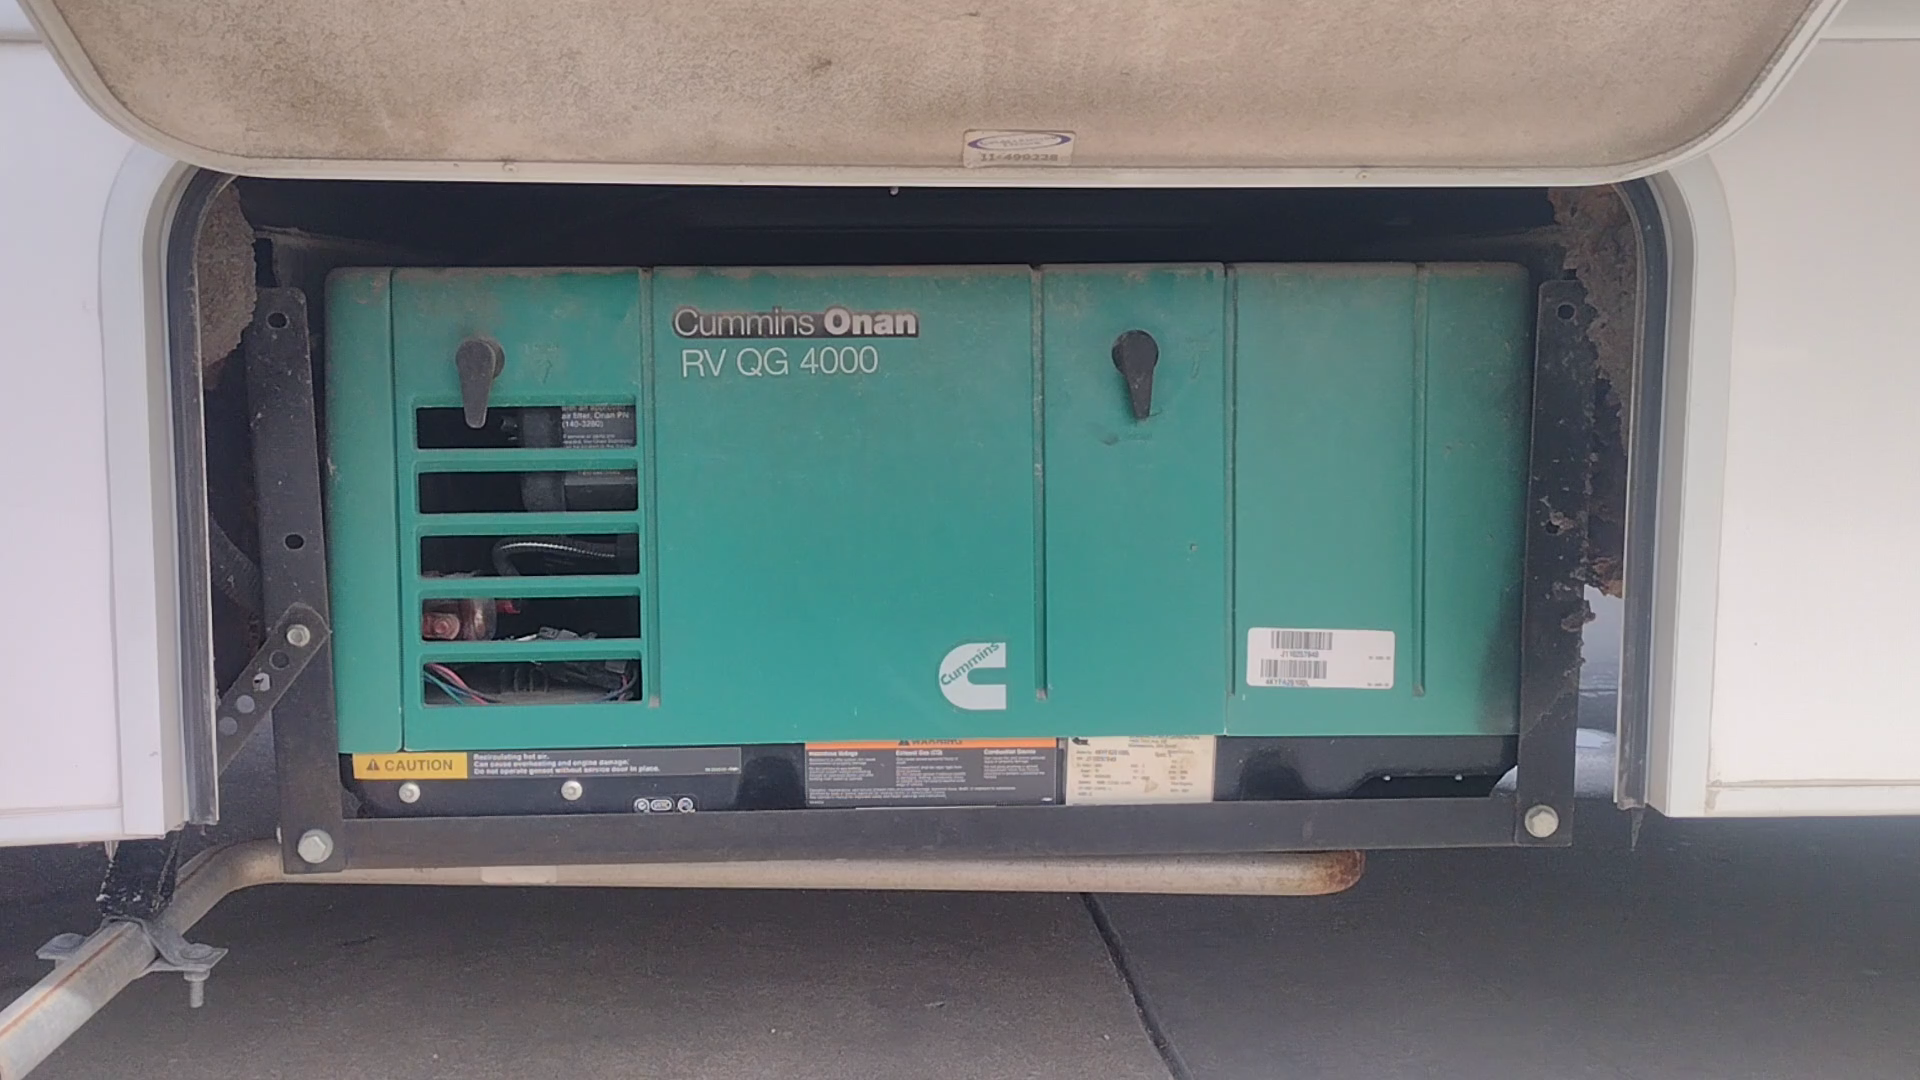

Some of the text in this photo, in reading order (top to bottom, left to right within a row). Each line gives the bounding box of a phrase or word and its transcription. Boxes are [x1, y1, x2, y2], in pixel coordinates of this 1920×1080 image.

[674, 307, 917, 336] Cummins Onan
[681, 345, 879, 378] RV QG 4000
[594, 411, 616, 419] Onan
[940, 643, 1000, 686] Cummins
[384, 759, 453, 771] CAUTION
[513, 760, 556, 768] overheating
[573, 759, 597, 767] engine
